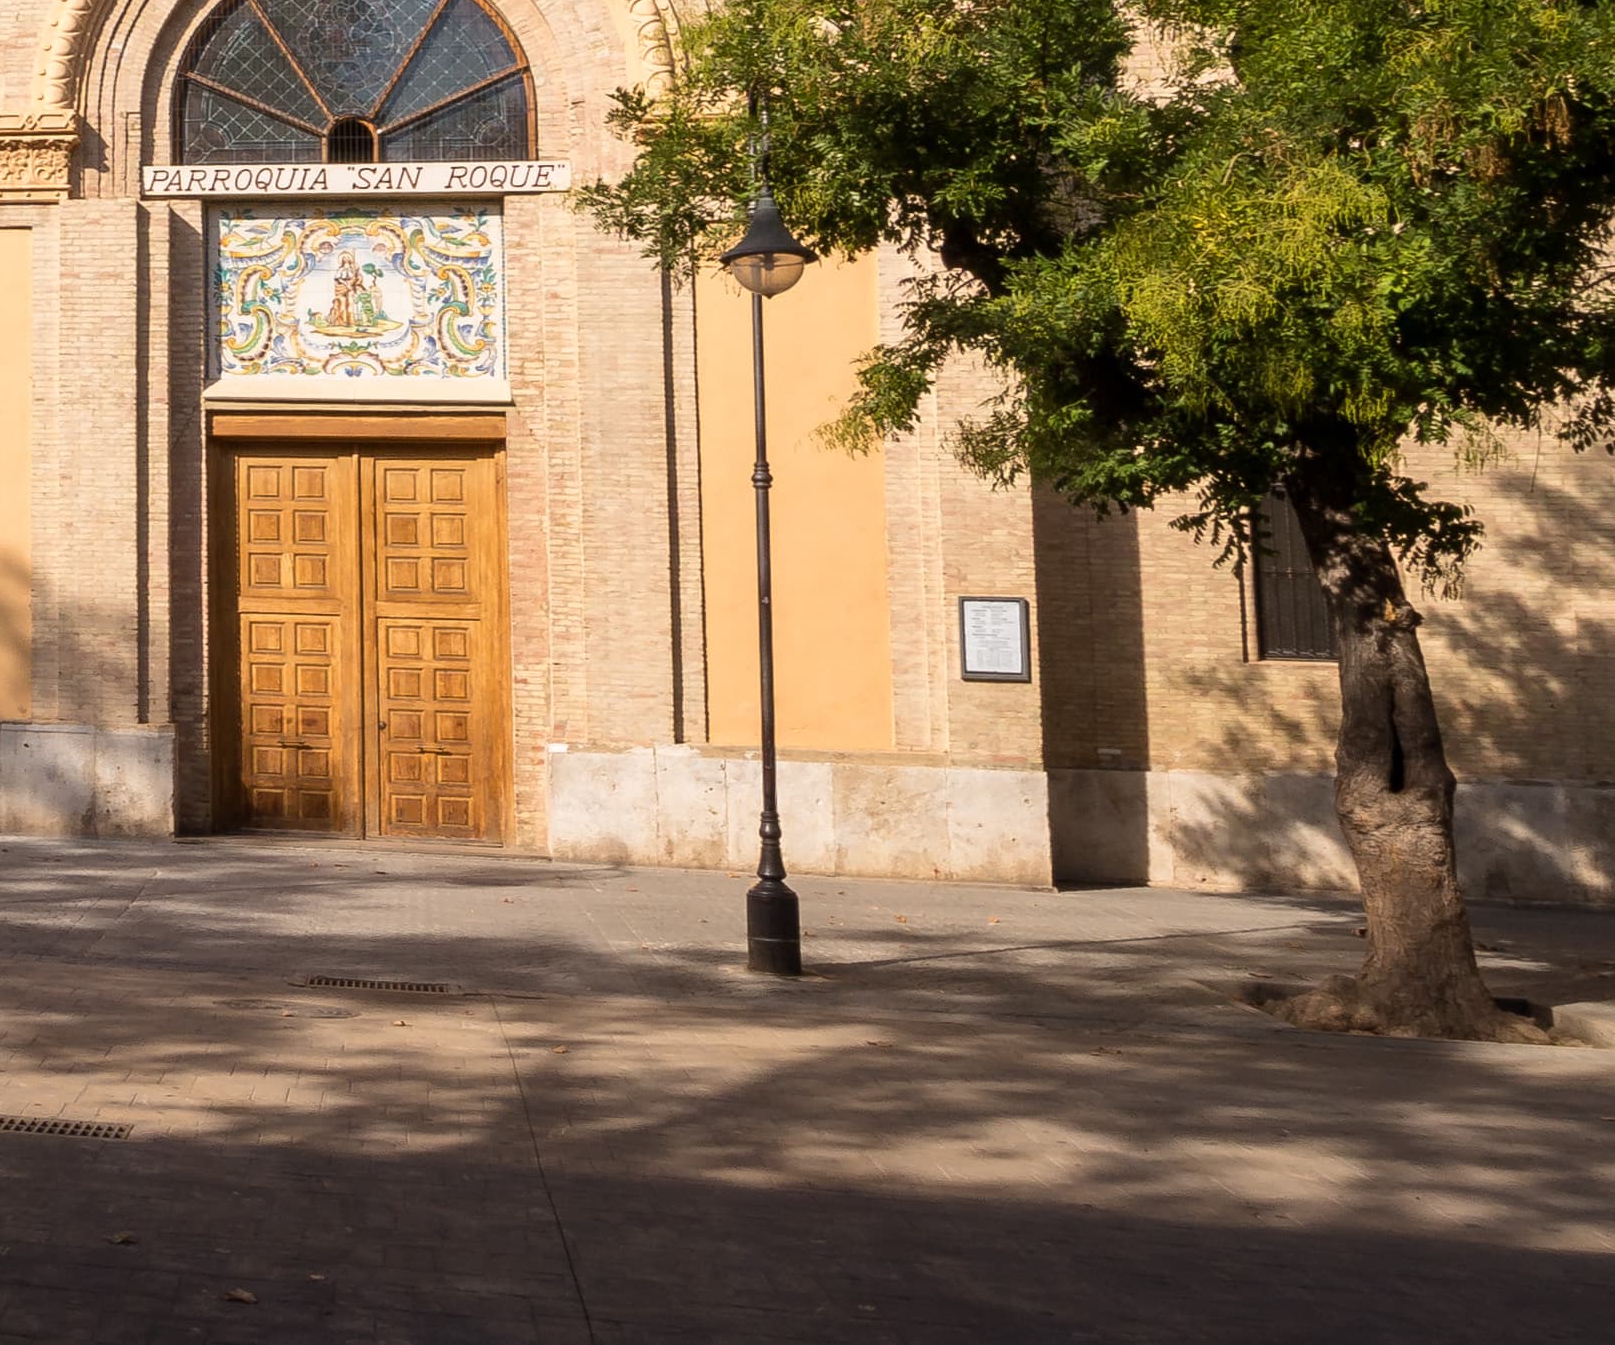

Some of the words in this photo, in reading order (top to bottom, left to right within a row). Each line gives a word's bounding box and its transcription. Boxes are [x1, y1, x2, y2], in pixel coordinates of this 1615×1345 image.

[145, 167, 329, 193] PARROQUIA
[347, 166, 424, 190] "SAN
[444, 164, 566, 189] ROQUE"
